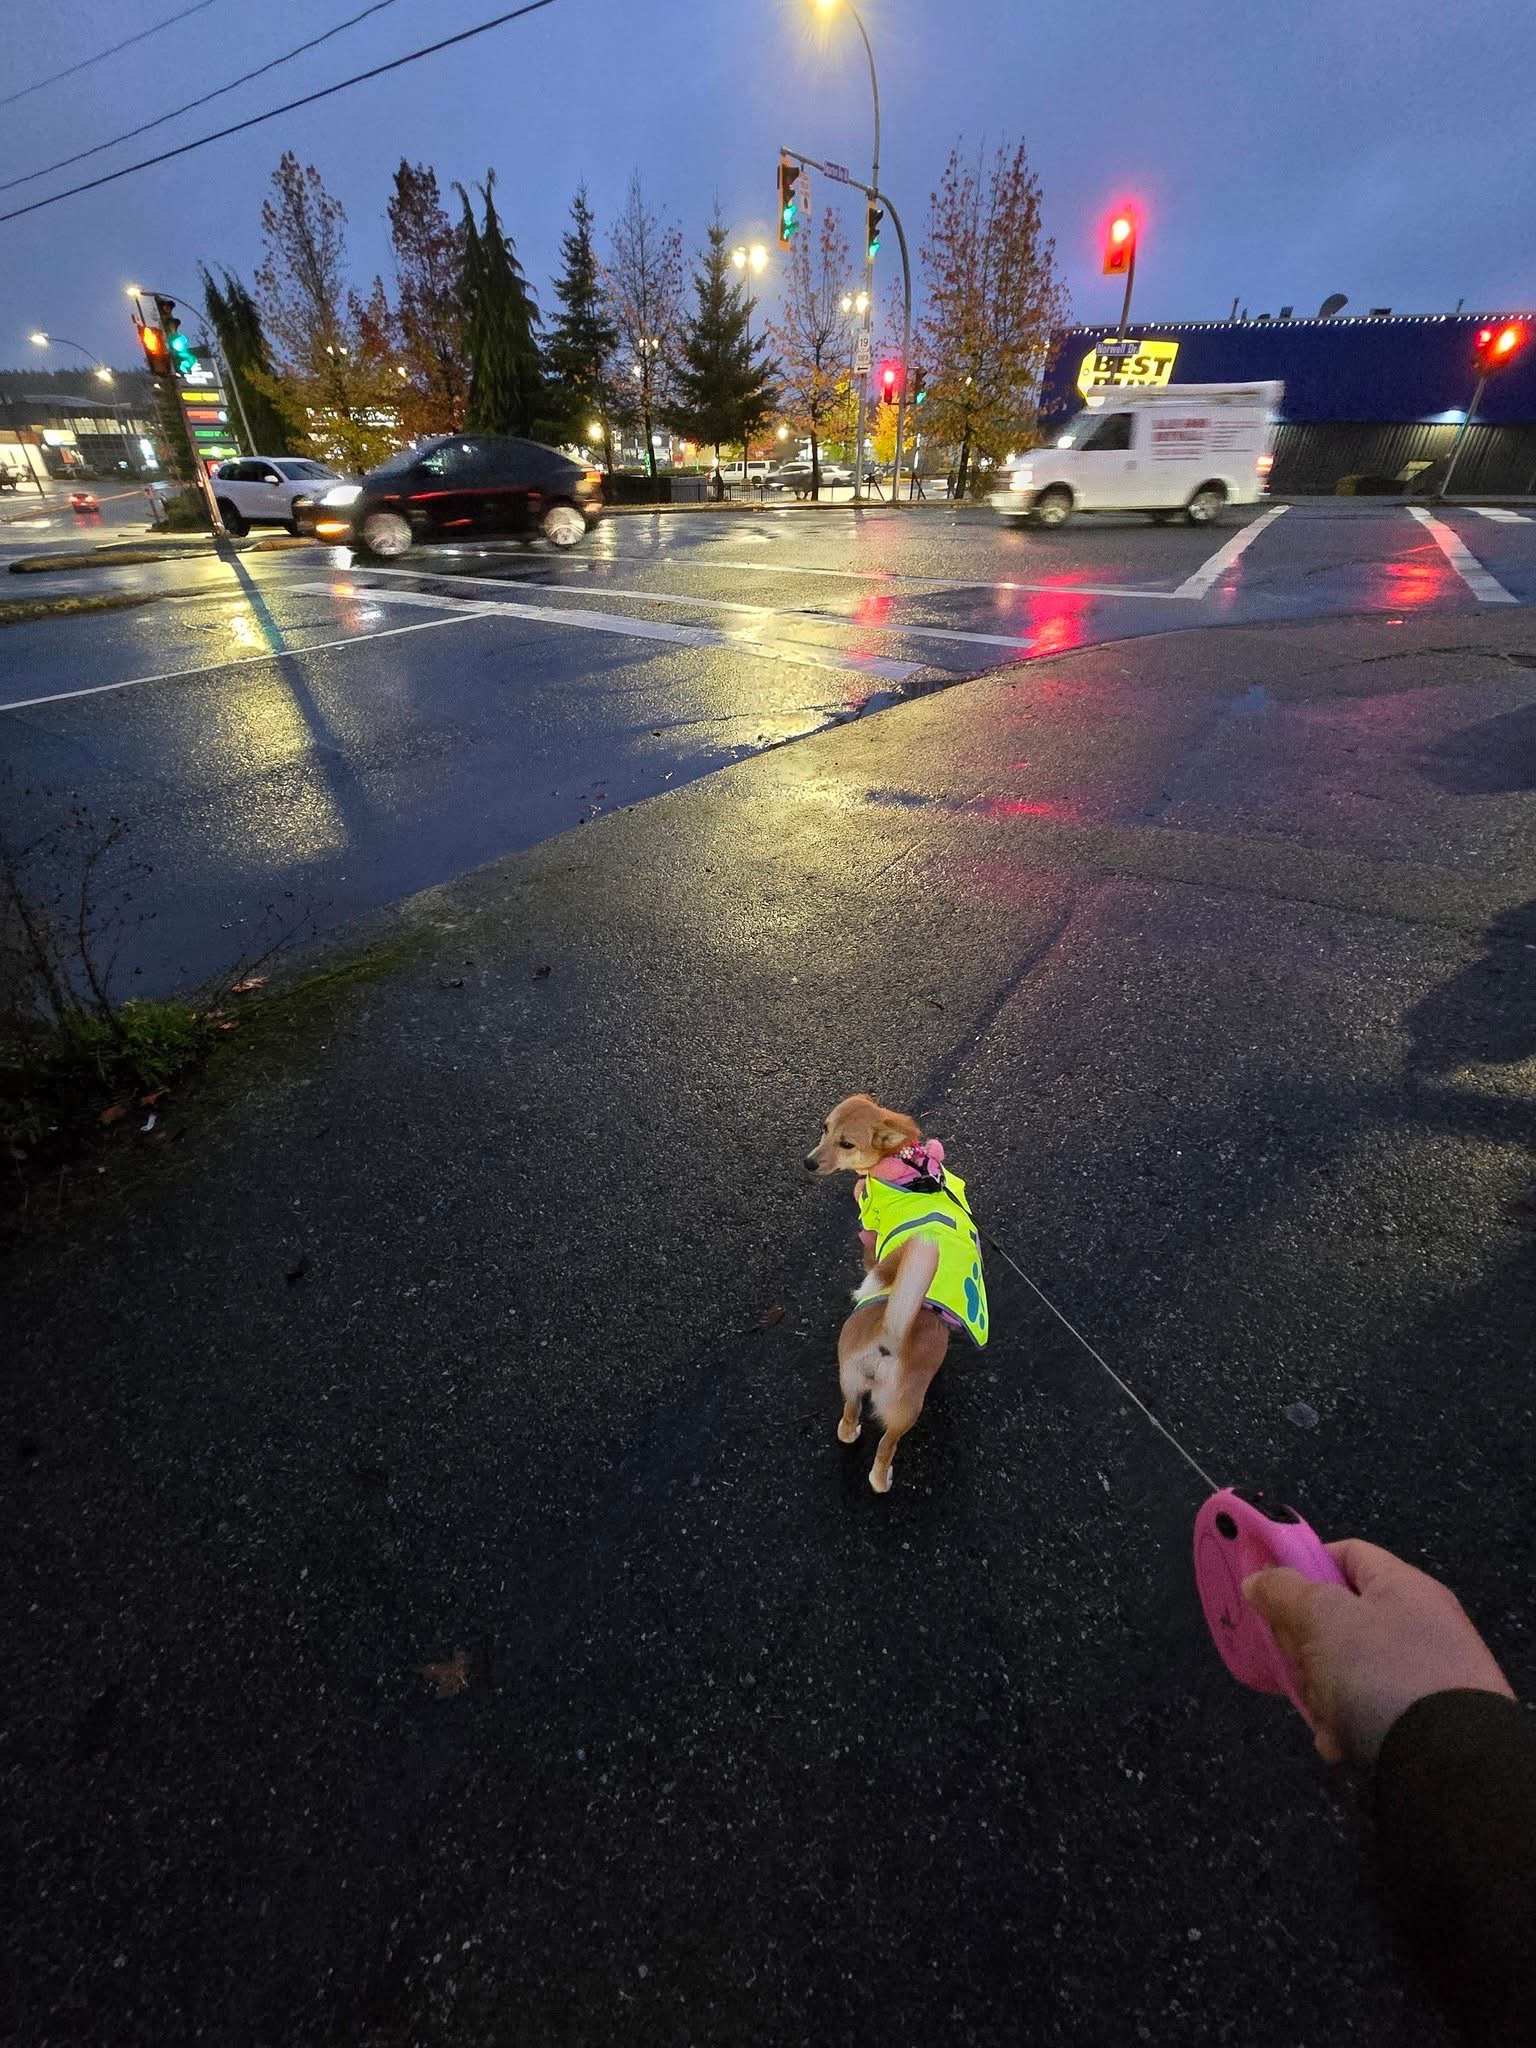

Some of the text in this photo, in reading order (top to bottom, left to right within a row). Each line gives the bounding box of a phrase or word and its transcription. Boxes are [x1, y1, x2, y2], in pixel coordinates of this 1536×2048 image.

[860, 337, 869, 347] 19
[1097, 343, 1139, 354] Norwell Dr.
[1093, 355, 1172, 377] BEST
